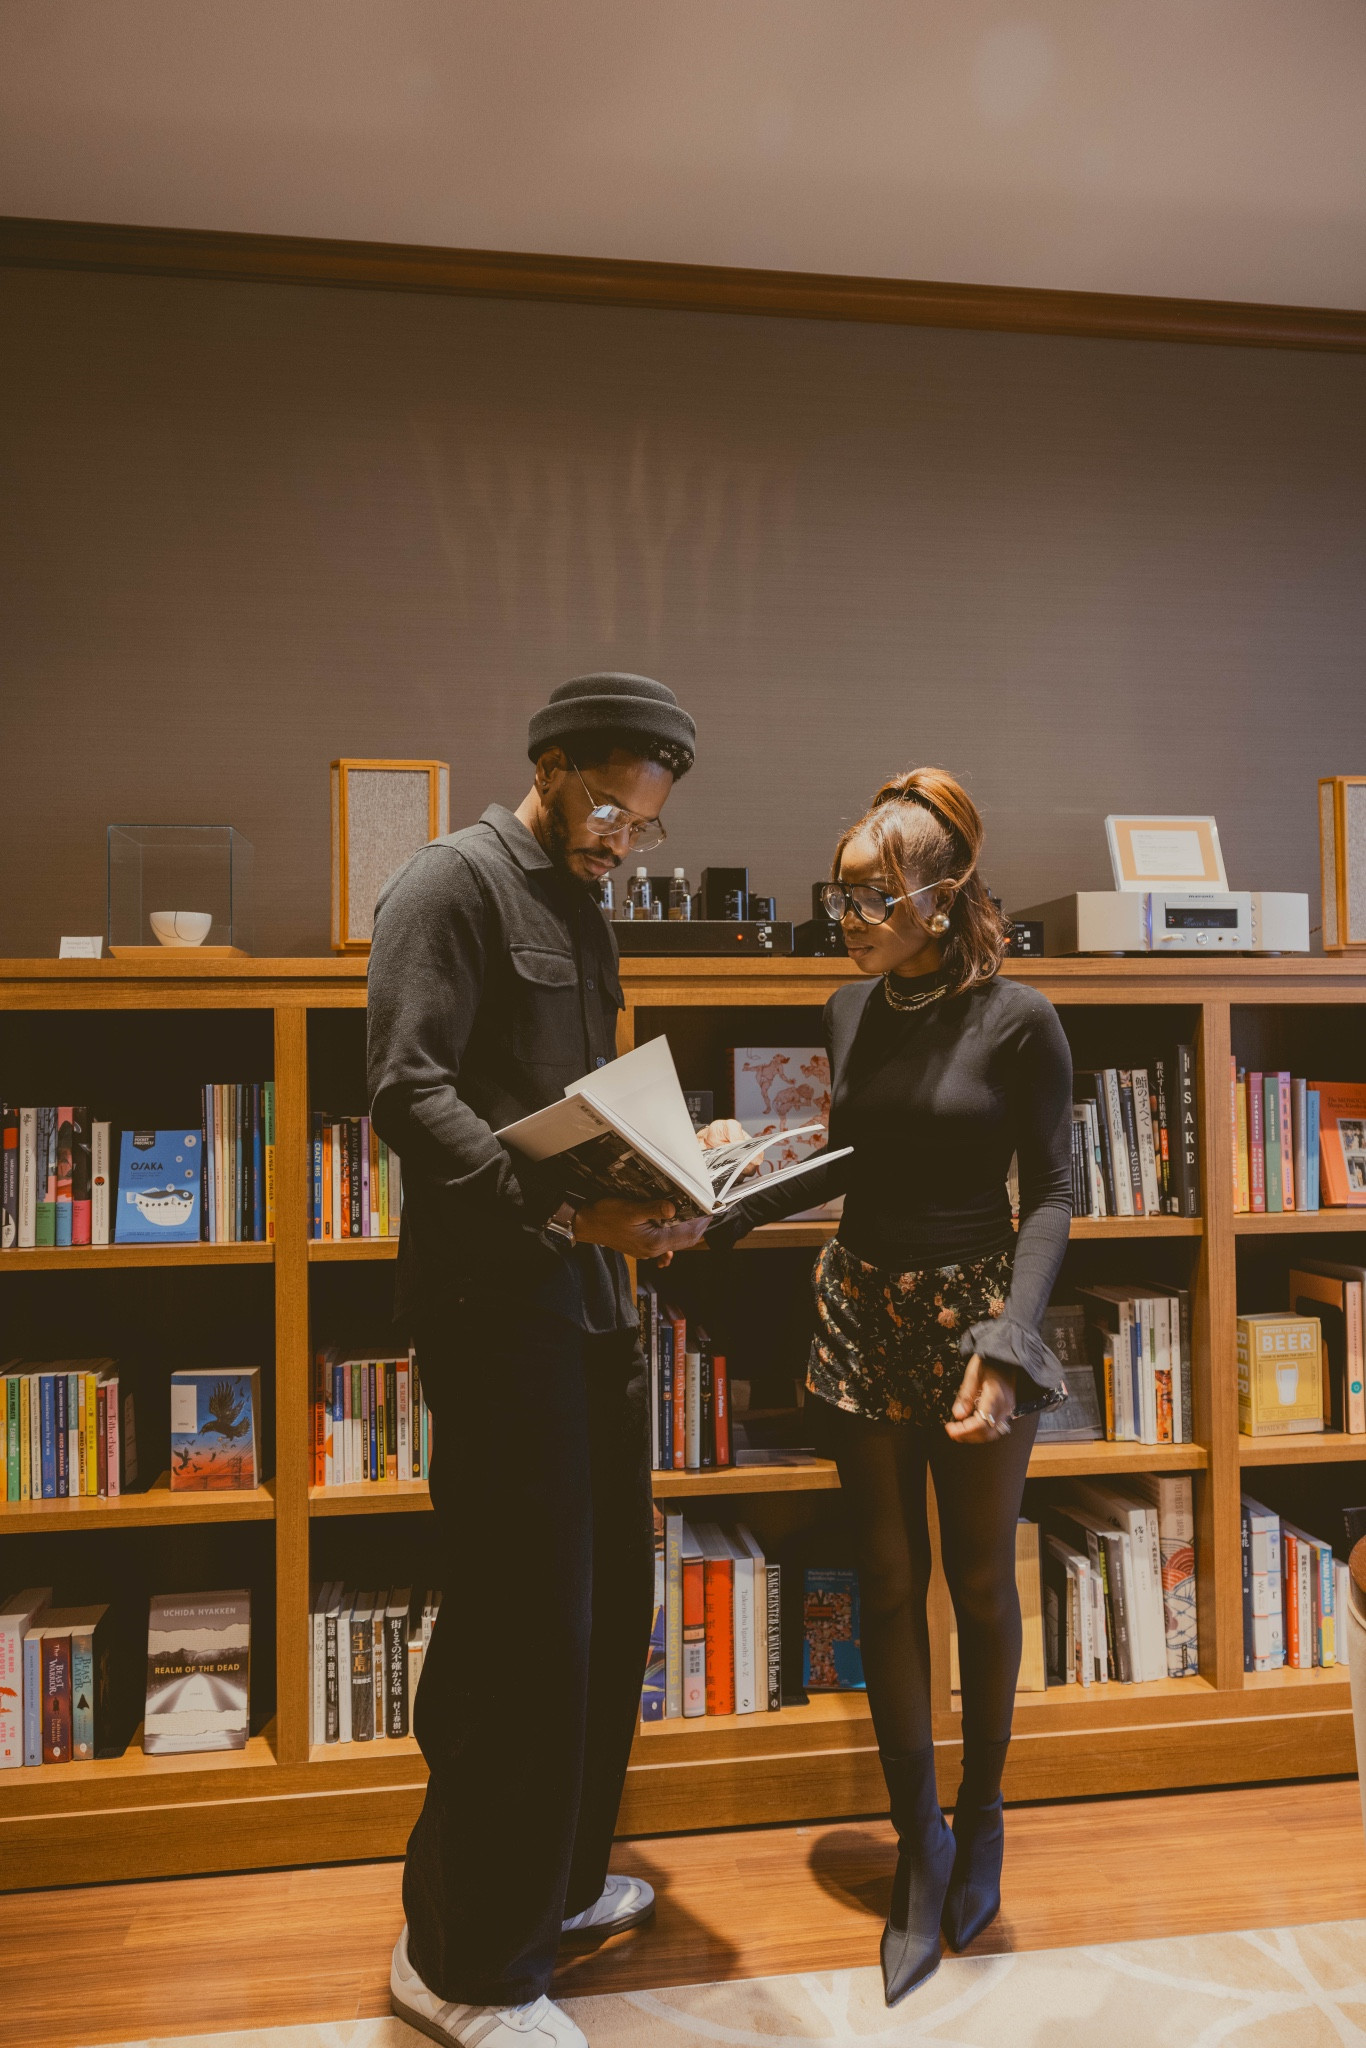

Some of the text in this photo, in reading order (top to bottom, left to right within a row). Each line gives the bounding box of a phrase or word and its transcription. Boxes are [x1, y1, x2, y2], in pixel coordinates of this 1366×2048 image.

[1184, 1092, 1195, 1164] SAKE
[131, 1162, 163, 1170] OSAKA
[1130, 1152, 1140, 1186] SUSHI
[1262, 1333, 1311, 1351] BEER
[1238, 1332, 1249, 1393] BEER
[1322, 1552, 1330, 1578] TRAIN
[163, 1607, 236, 1617] UCHIDA HYAKKEN
[669, 1540, 678, 1684] ART & DESIGN HOTELS
[768, 1572, 779, 1624] SAGMEISTER
[768, 1626, 779, 1634] &
[82, 1658, 91, 1685] BEAST
[217, 1664, 240, 1672] DEAD
[391, 1620, 402, 1695] 街とその不確かな壁
[48, 1659, 57, 1695] WARRIOR
[55, 1665, 64, 1688] BEAST
[74, 1655, 83, 1692] PLAYER
[393, 1701, 401, 1729] 村上春樹
